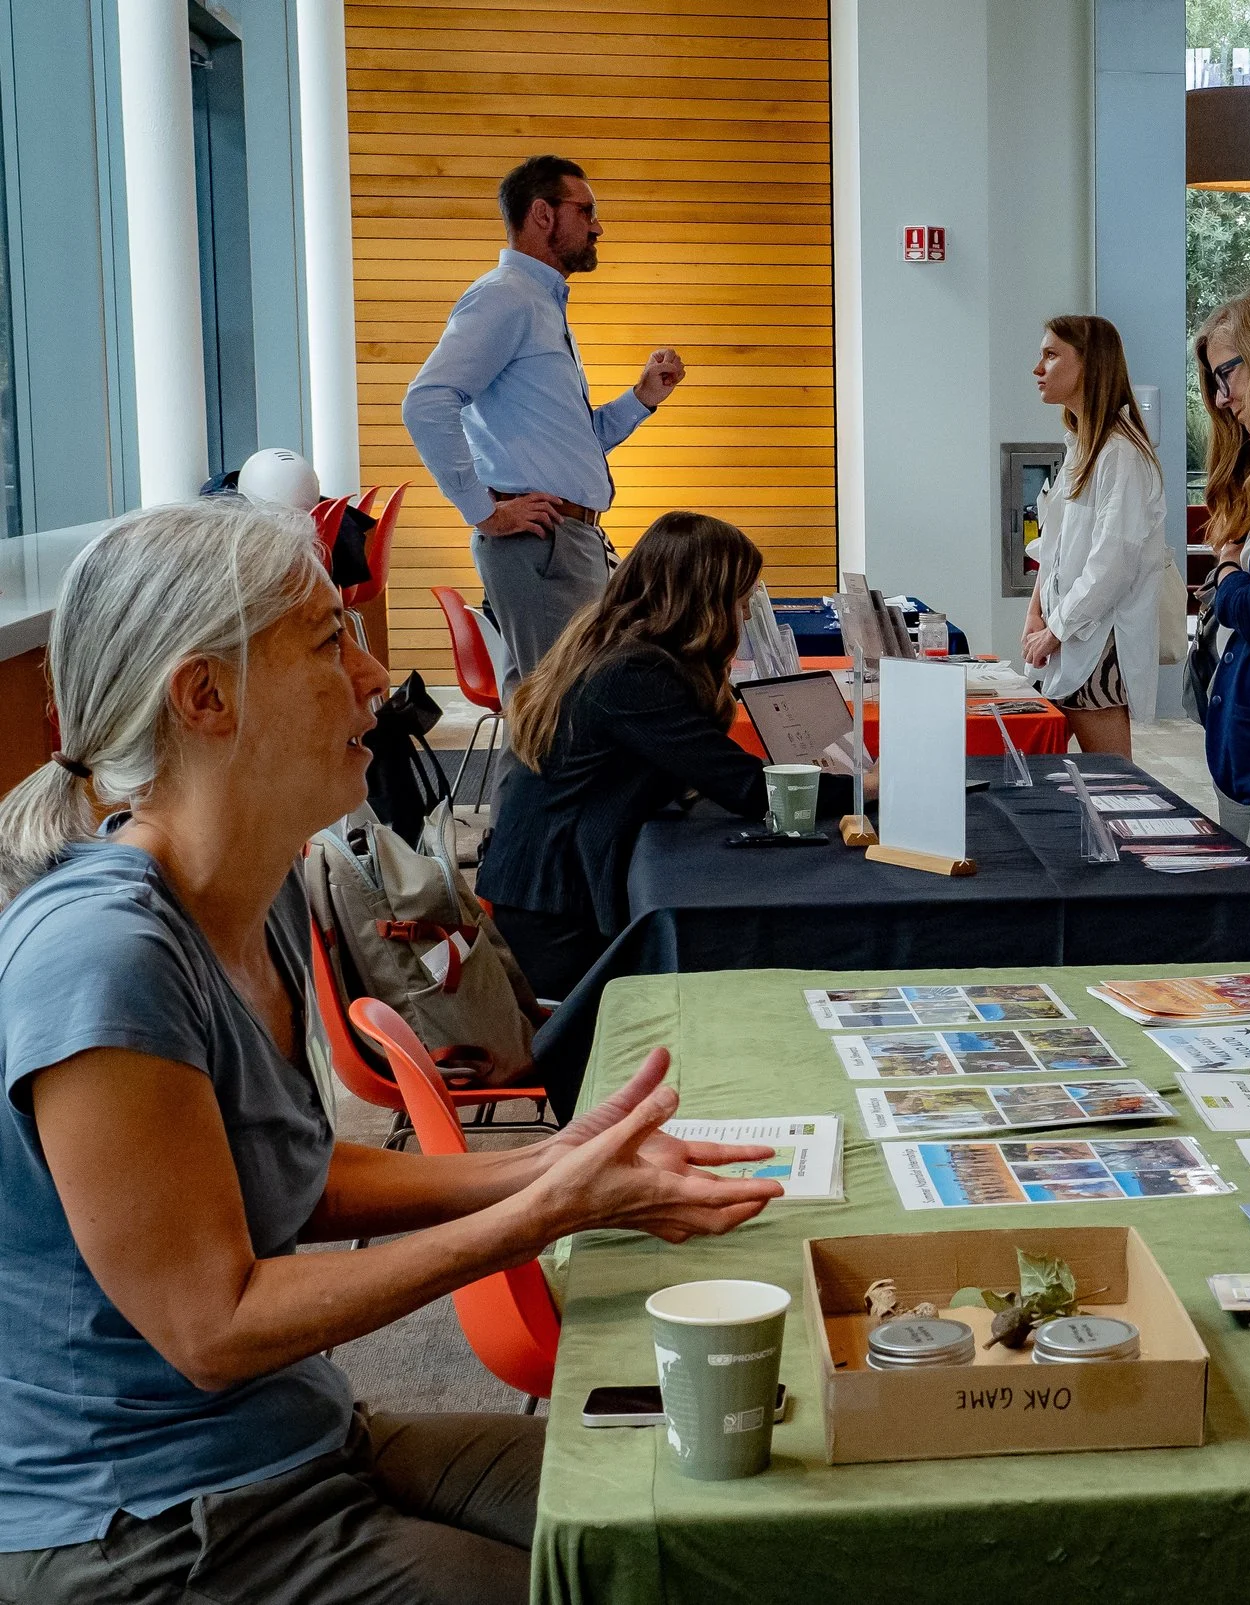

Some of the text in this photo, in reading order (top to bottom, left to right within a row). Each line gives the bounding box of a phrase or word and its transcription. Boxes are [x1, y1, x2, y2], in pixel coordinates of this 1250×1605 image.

[1221, 1036, 1243, 1047] ALTO
[1230, 1080, 1249, 1093] email
[902, 1148, 921, 1168] Internship
[956, 1387, 1071, 1411] OAK GAME
